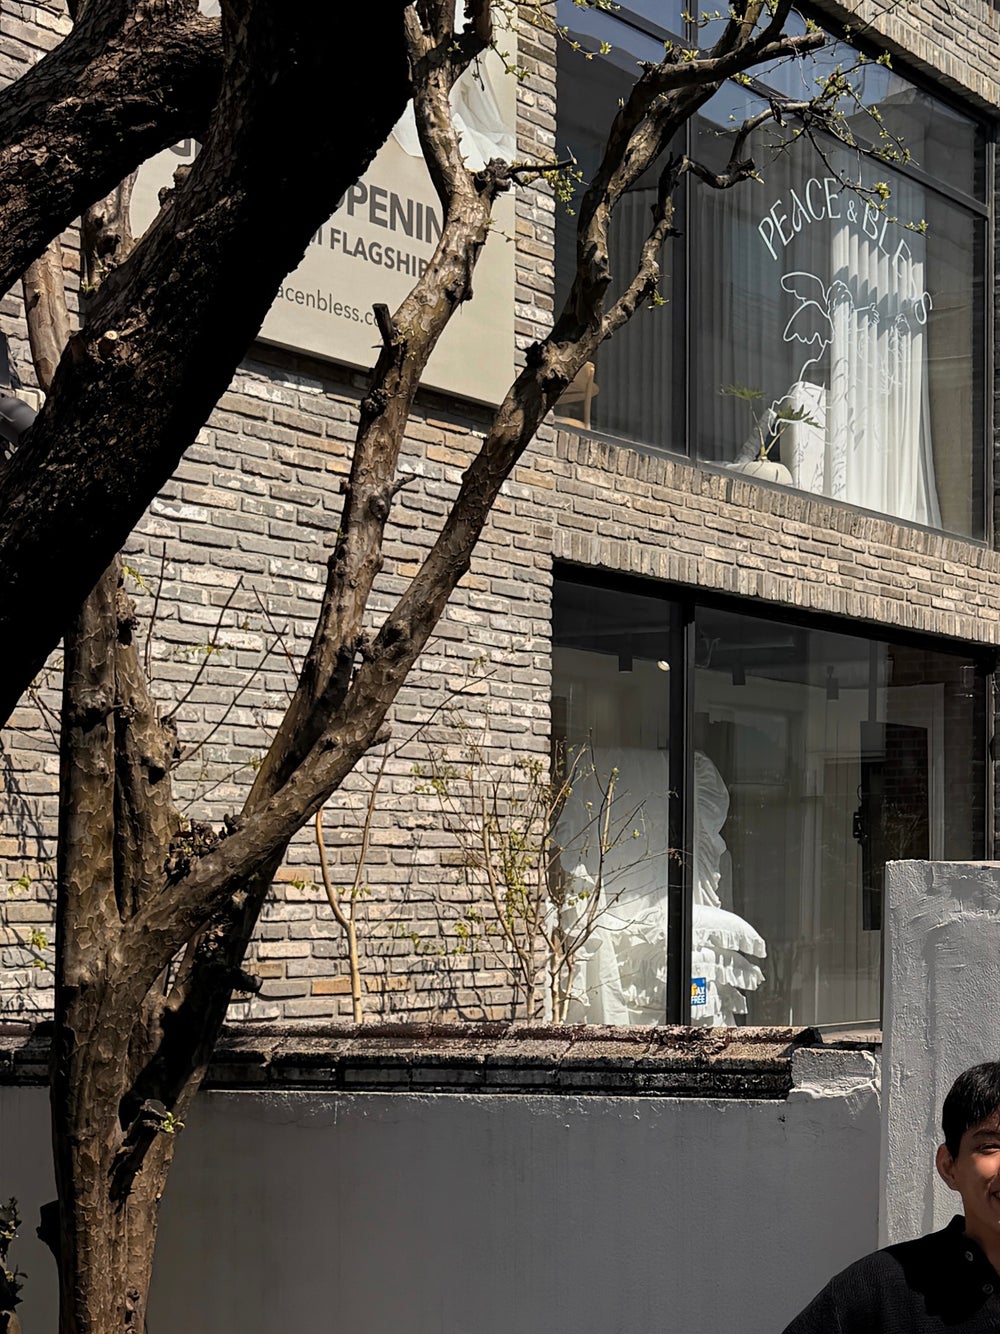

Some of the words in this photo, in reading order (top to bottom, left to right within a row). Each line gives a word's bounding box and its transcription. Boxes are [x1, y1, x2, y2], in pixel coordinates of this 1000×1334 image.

[336, 180, 443, 245] PENIN
[757, 177, 841, 261] PEACE
[846, 199, 859, 224] &
